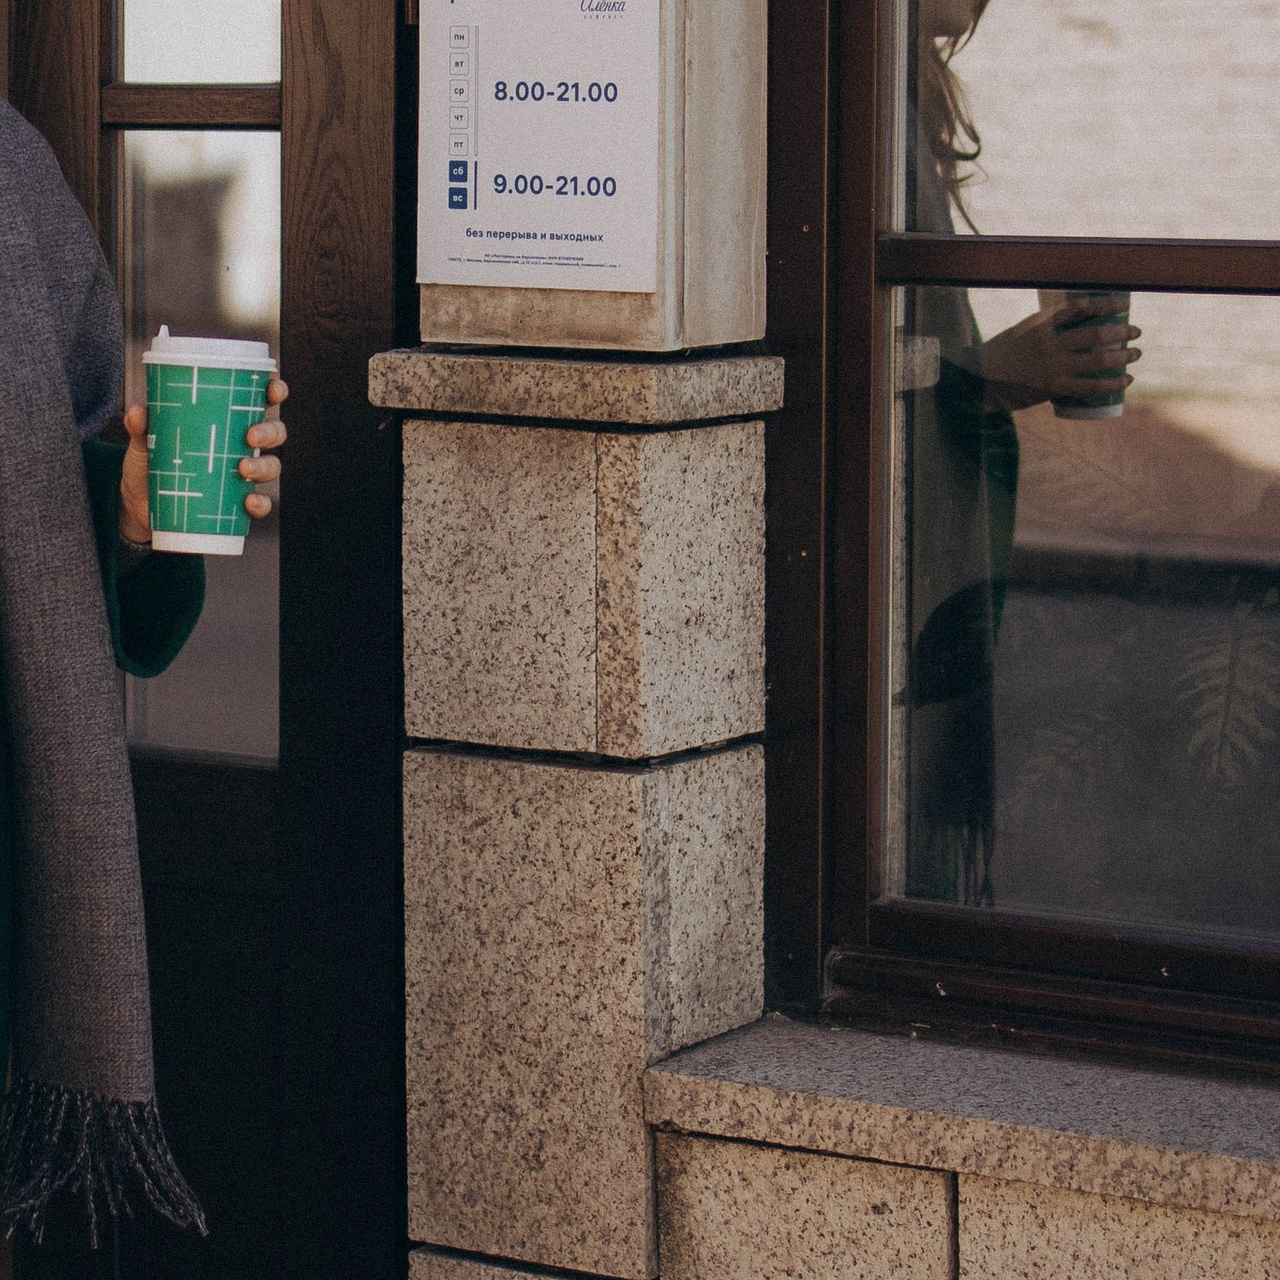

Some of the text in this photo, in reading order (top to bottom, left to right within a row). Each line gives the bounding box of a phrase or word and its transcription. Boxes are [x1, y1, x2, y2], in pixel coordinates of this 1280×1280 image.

[453, 87, 465, 96] ср
[494, 80, 618, 102] 8.00-21.00
[452, 166, 464, 176] сб
[493, 173, 617, 197] 9.00-21.00
[465, 228, 484, 238] без
[486, 230, 538, 240] перерыва
[549, 232, 604, 243] выходных
